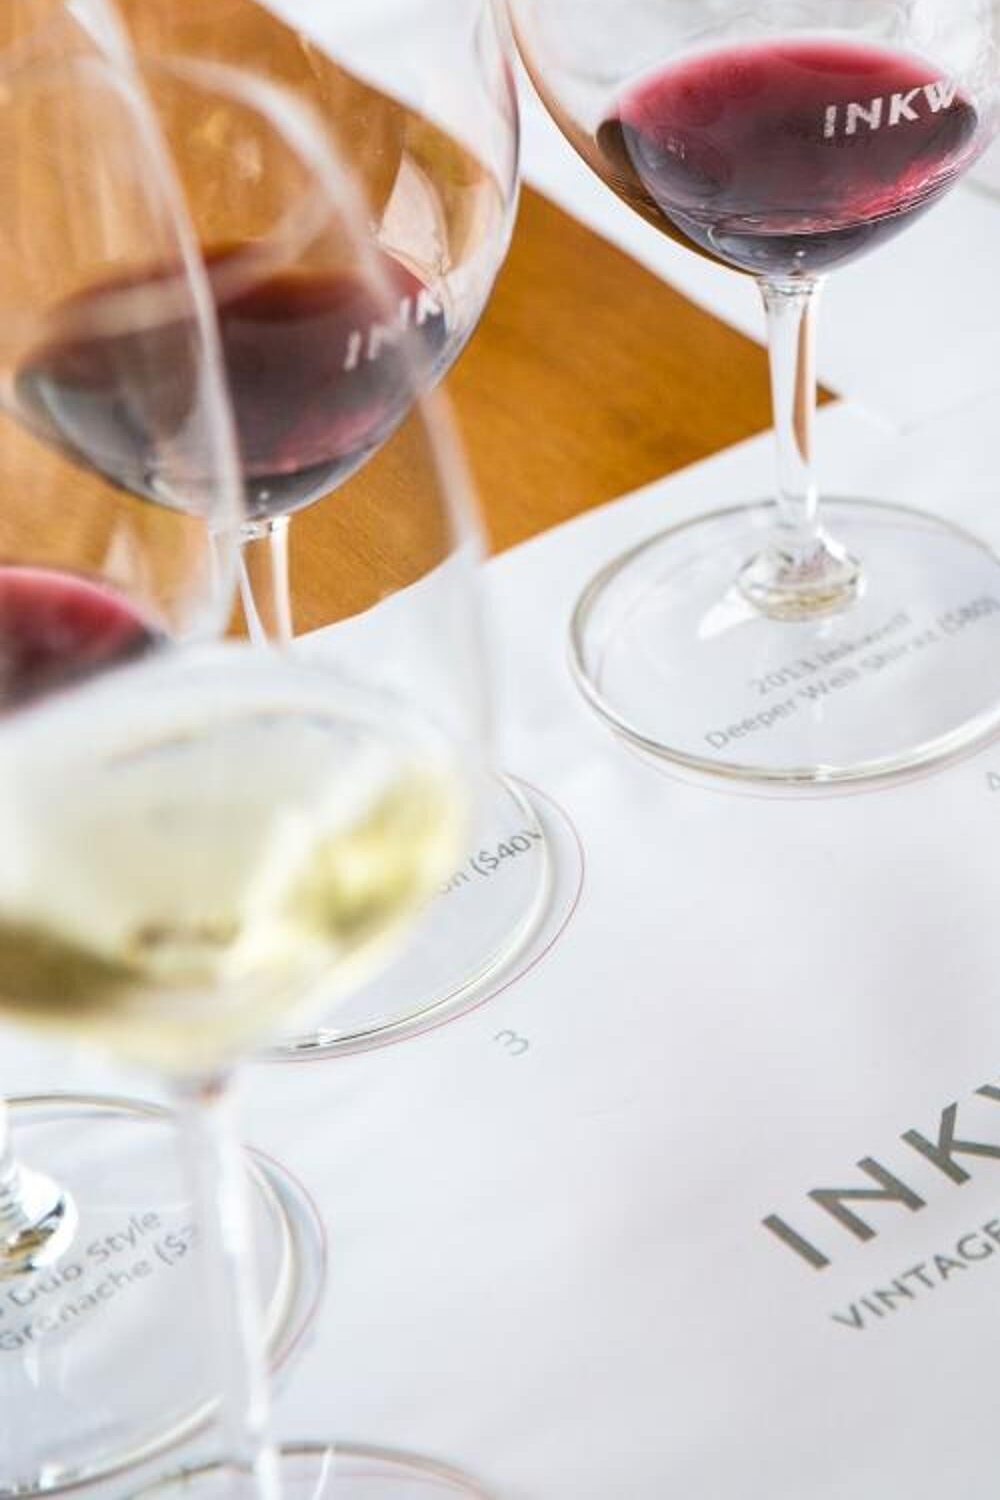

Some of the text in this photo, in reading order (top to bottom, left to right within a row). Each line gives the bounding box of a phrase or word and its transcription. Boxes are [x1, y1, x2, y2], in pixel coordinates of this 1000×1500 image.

[823, 80, 958, 140] INKW
[704, 698, 798, 750] Deeper
[796, 664, 862, 700] Well
[493, 1027, 530, 1058] 3
[86, 1211, 160, 1265] Style
